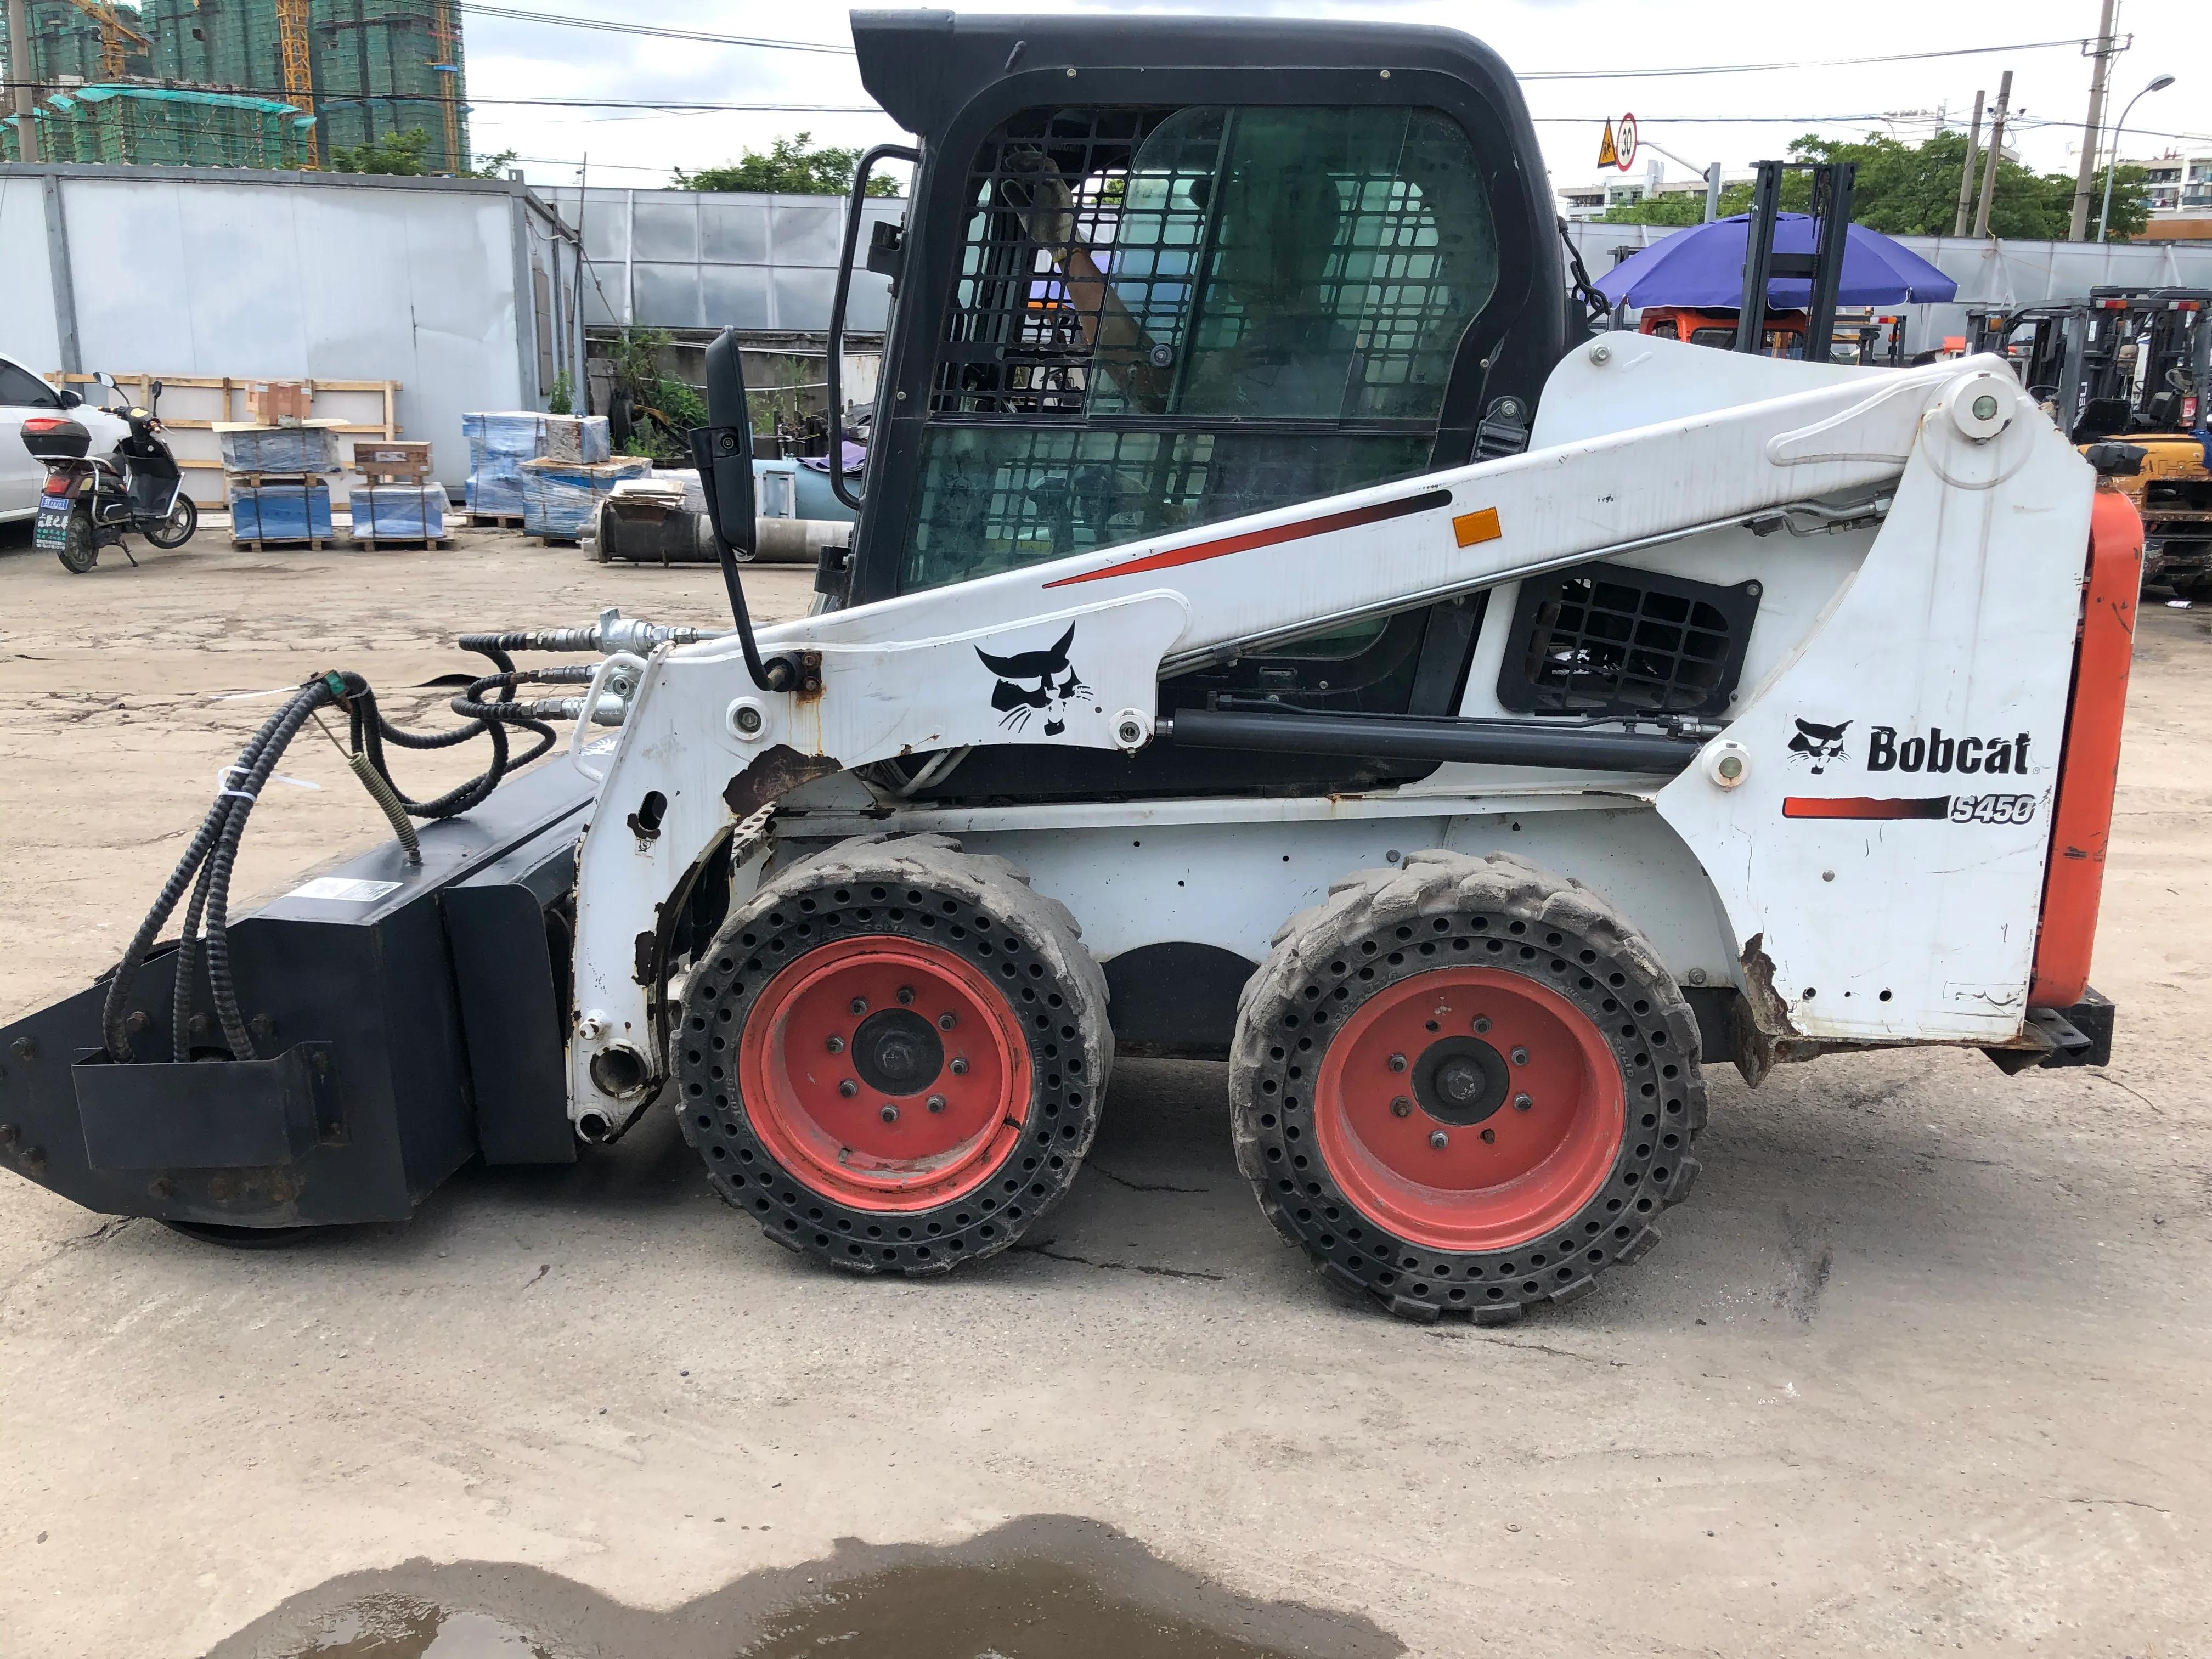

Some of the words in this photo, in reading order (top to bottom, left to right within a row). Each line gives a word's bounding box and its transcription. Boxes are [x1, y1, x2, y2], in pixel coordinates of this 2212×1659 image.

[1622, 127, 1632, 156] 30
[1867, 726, 2031, 775] Bobcat
[1952, 794, 2035, 825] S450
[1613, 1036, 1634, 1078] SOLID
